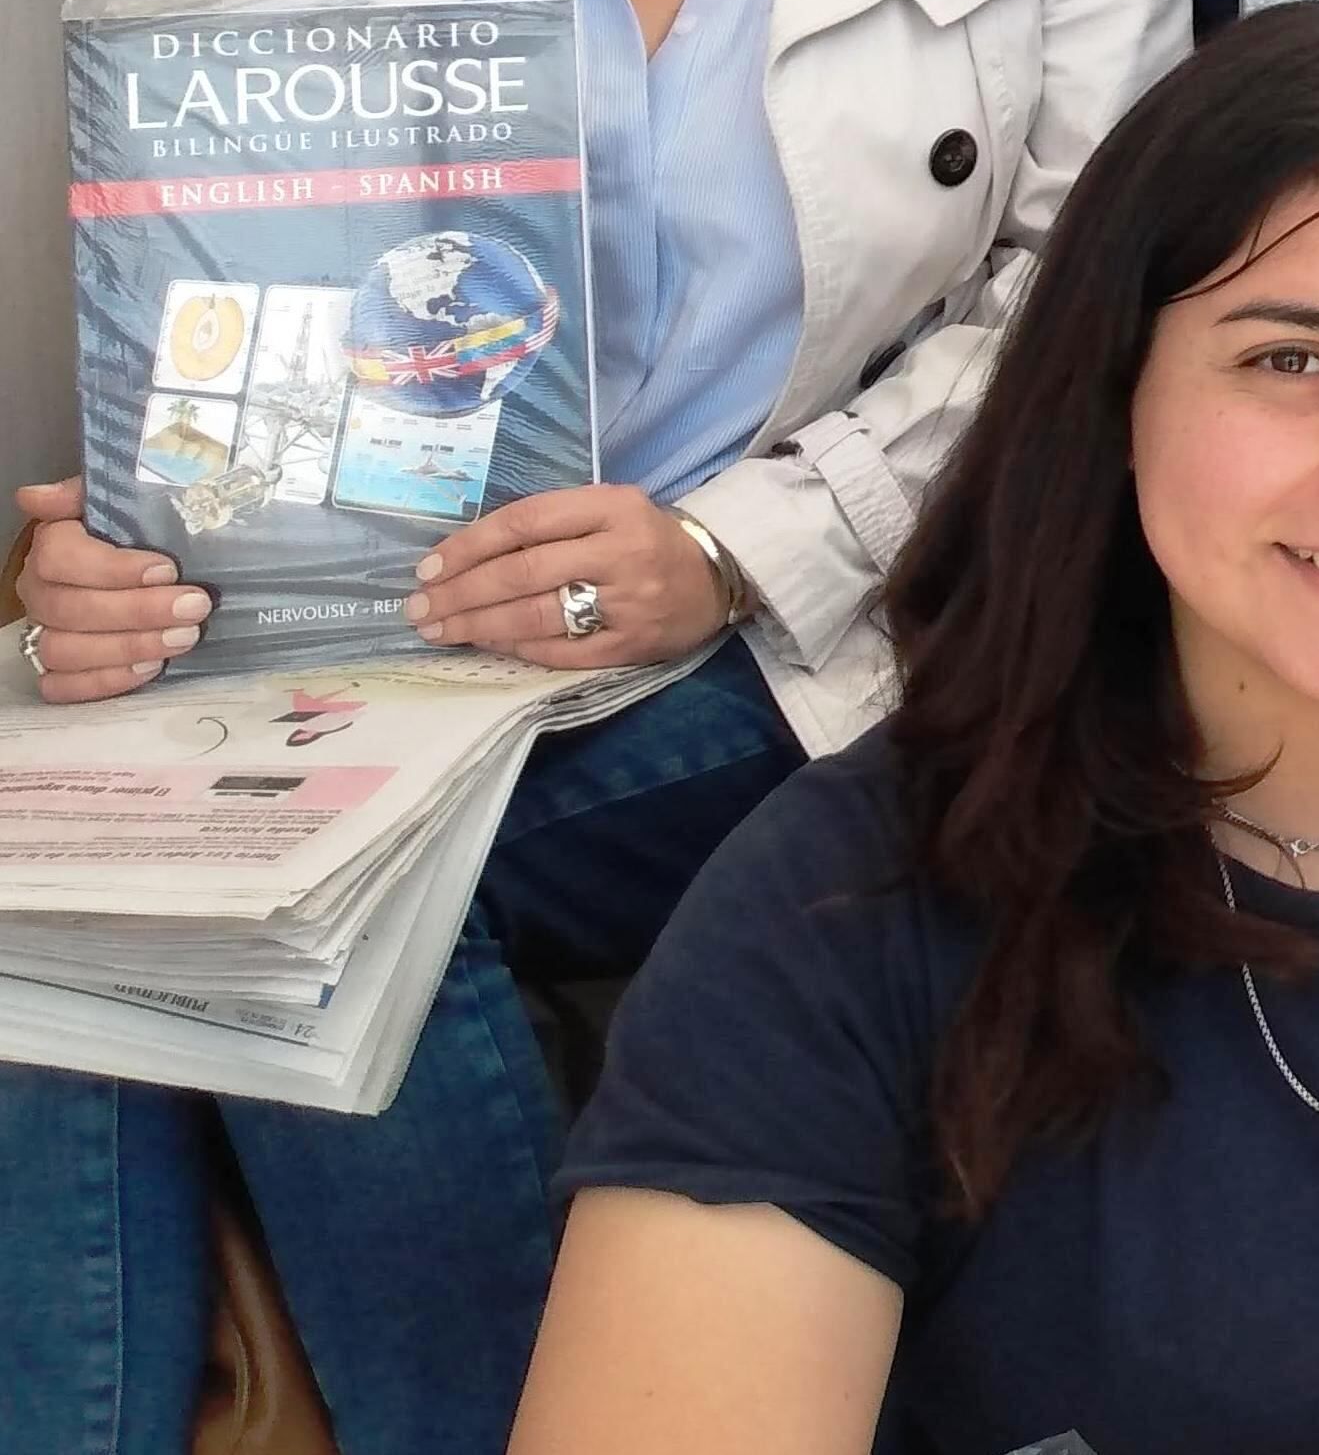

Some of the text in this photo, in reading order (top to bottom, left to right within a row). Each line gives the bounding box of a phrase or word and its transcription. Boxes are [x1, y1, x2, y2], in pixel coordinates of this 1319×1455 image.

[151, 20, 500, 60] DICCIONARIO
[126, 56, 529, 130] LAROUSSE
[152, 122, 514, 158] BILINGÜE ILUSTRADO
[160, 177, 315, 208] ENGLISH
[358, 166, 505, 196] SPANISH
[258, 601, 358, 625] NERVOUSLY
[67, 784, 108, 795] diario
